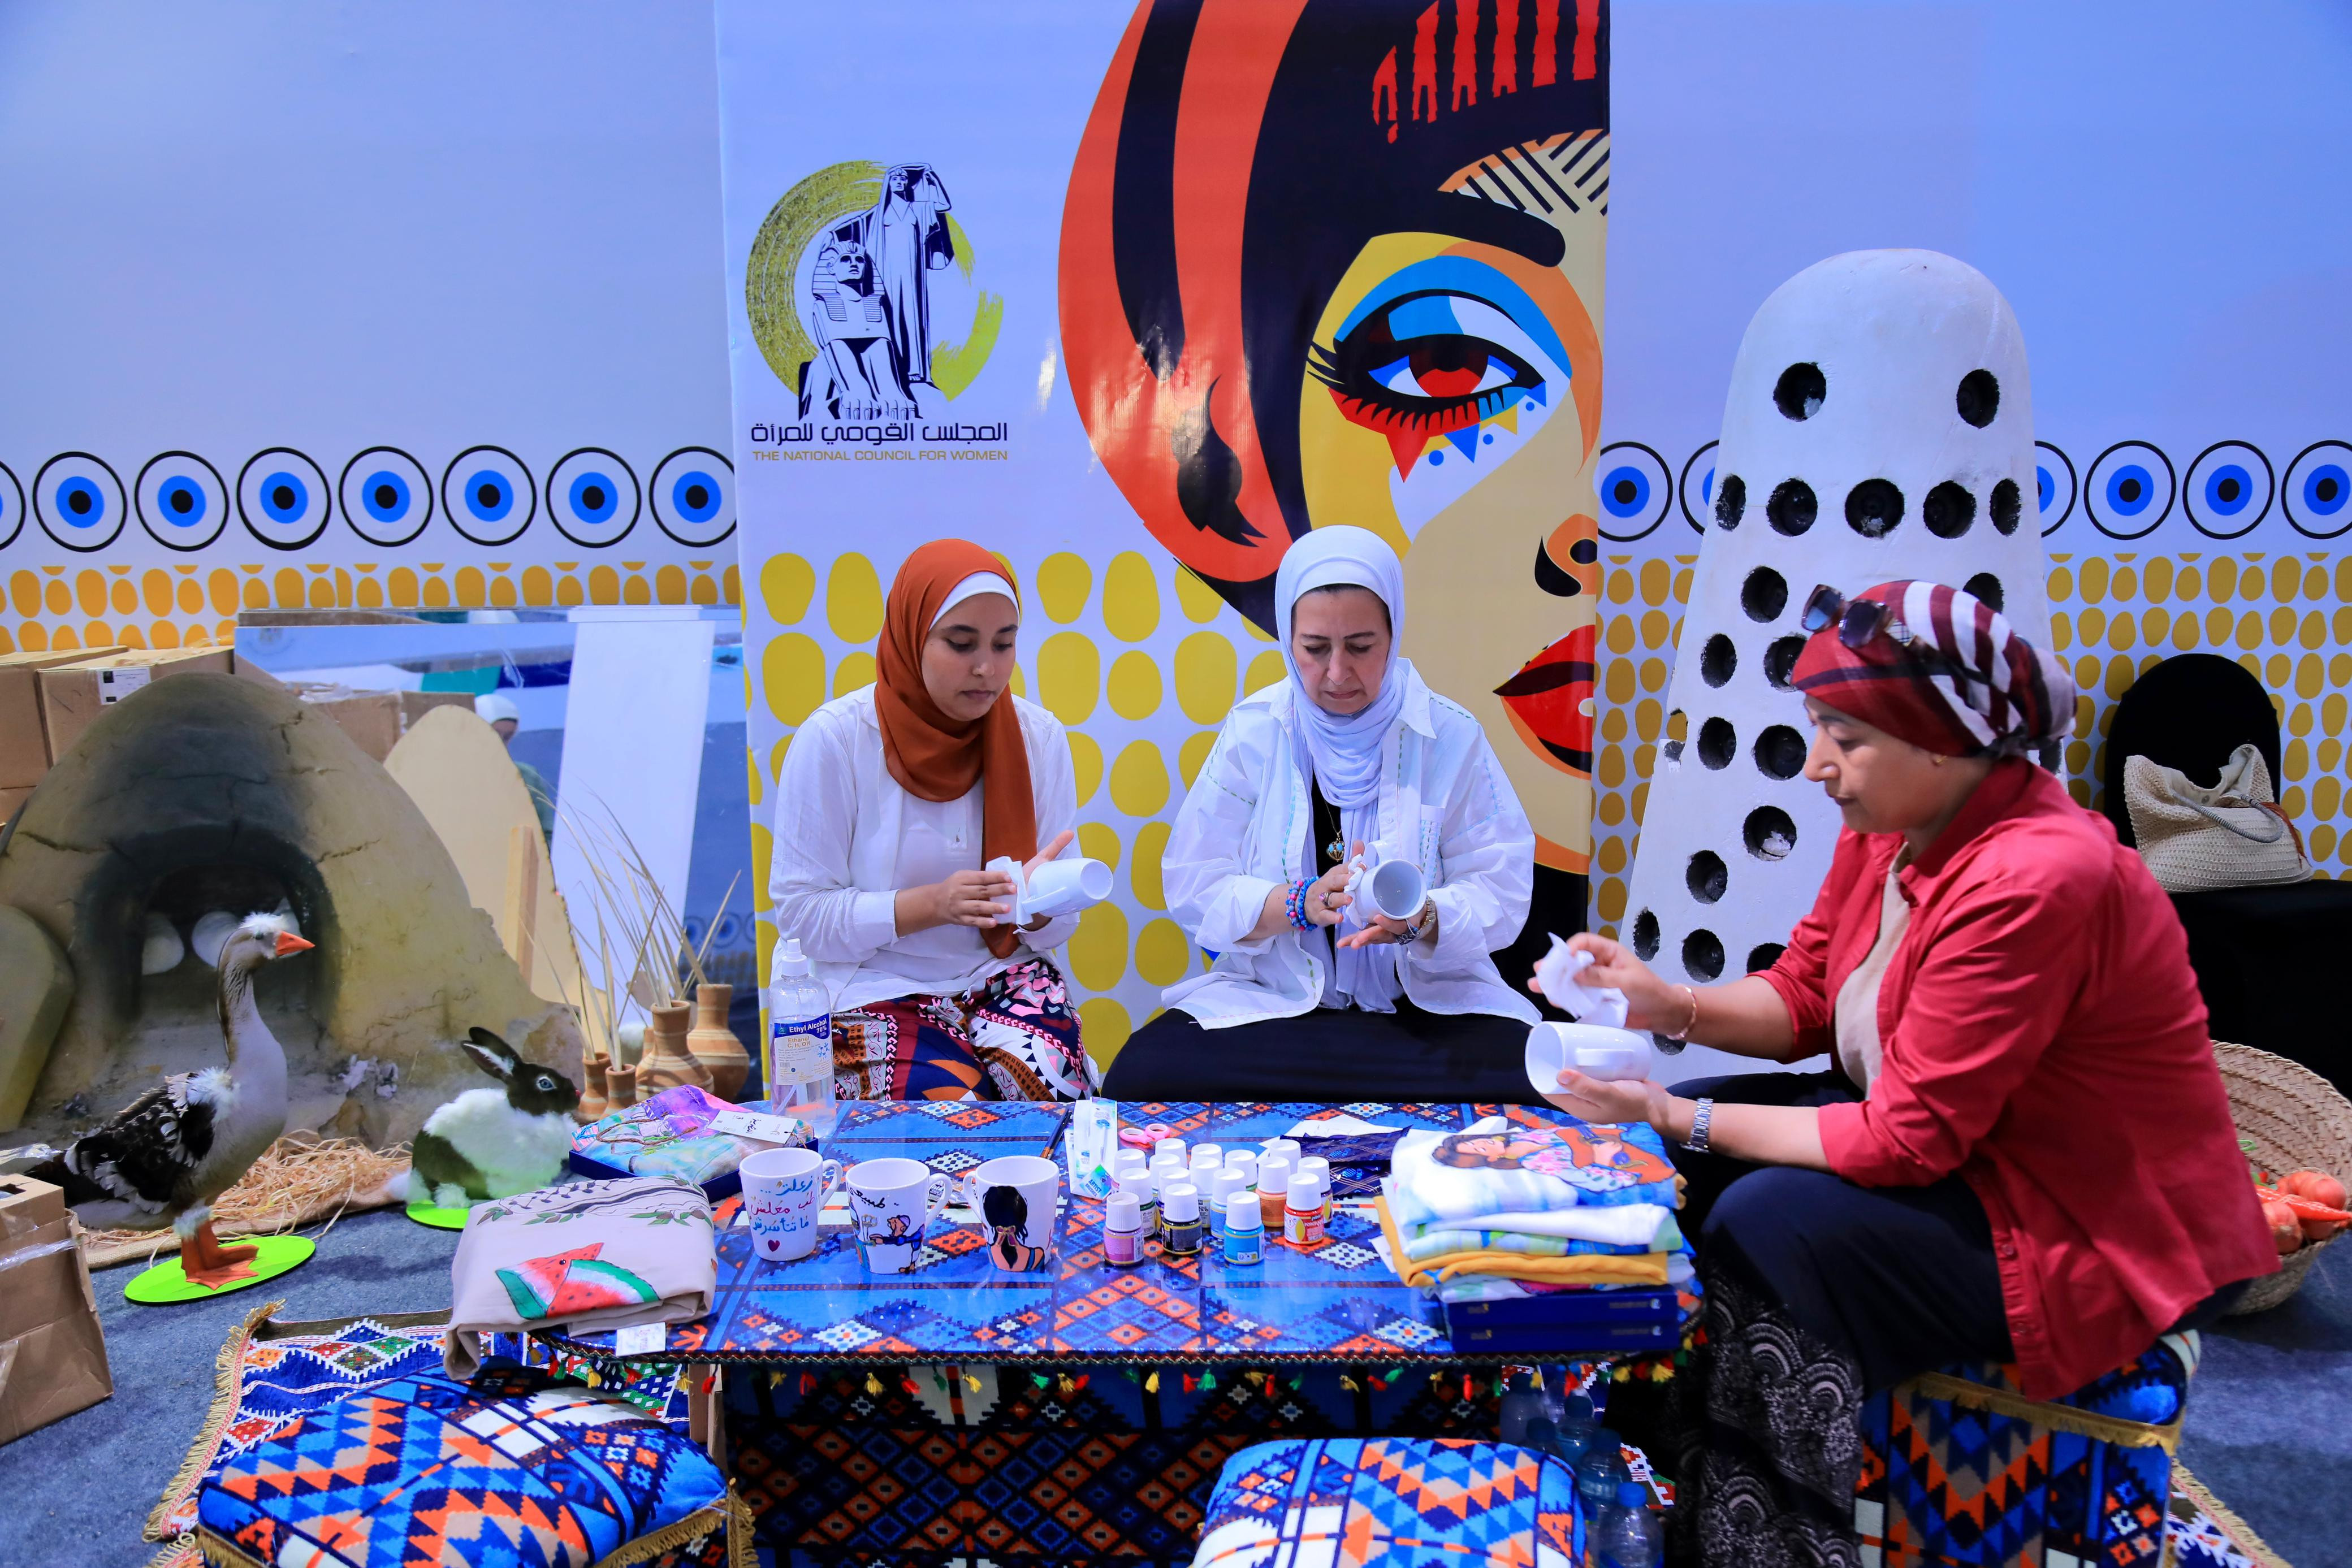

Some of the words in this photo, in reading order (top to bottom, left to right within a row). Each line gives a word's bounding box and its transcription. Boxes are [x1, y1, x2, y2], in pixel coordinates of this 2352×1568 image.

[751, 423, 812, 446] للمرأة
[822, 422, 914, 445] القومي
[923, 422, 1008, 444] المجلس
[753, 451, 779, 461] THE
[784, 451, 850, 461] NATIONAL
[854, 451, 915, 461] COUNCIL
[919, 451, 946, 461] FOR
[950, 451, 1008, 461] WOMEN
[789, 1025, 806, 1033] Ethyl
[807, 1018, 827, 1030] Alcohol
[816, 1025, 827, 1034] 70%
[1088, 1179, 1102, 1193] ARTIST
